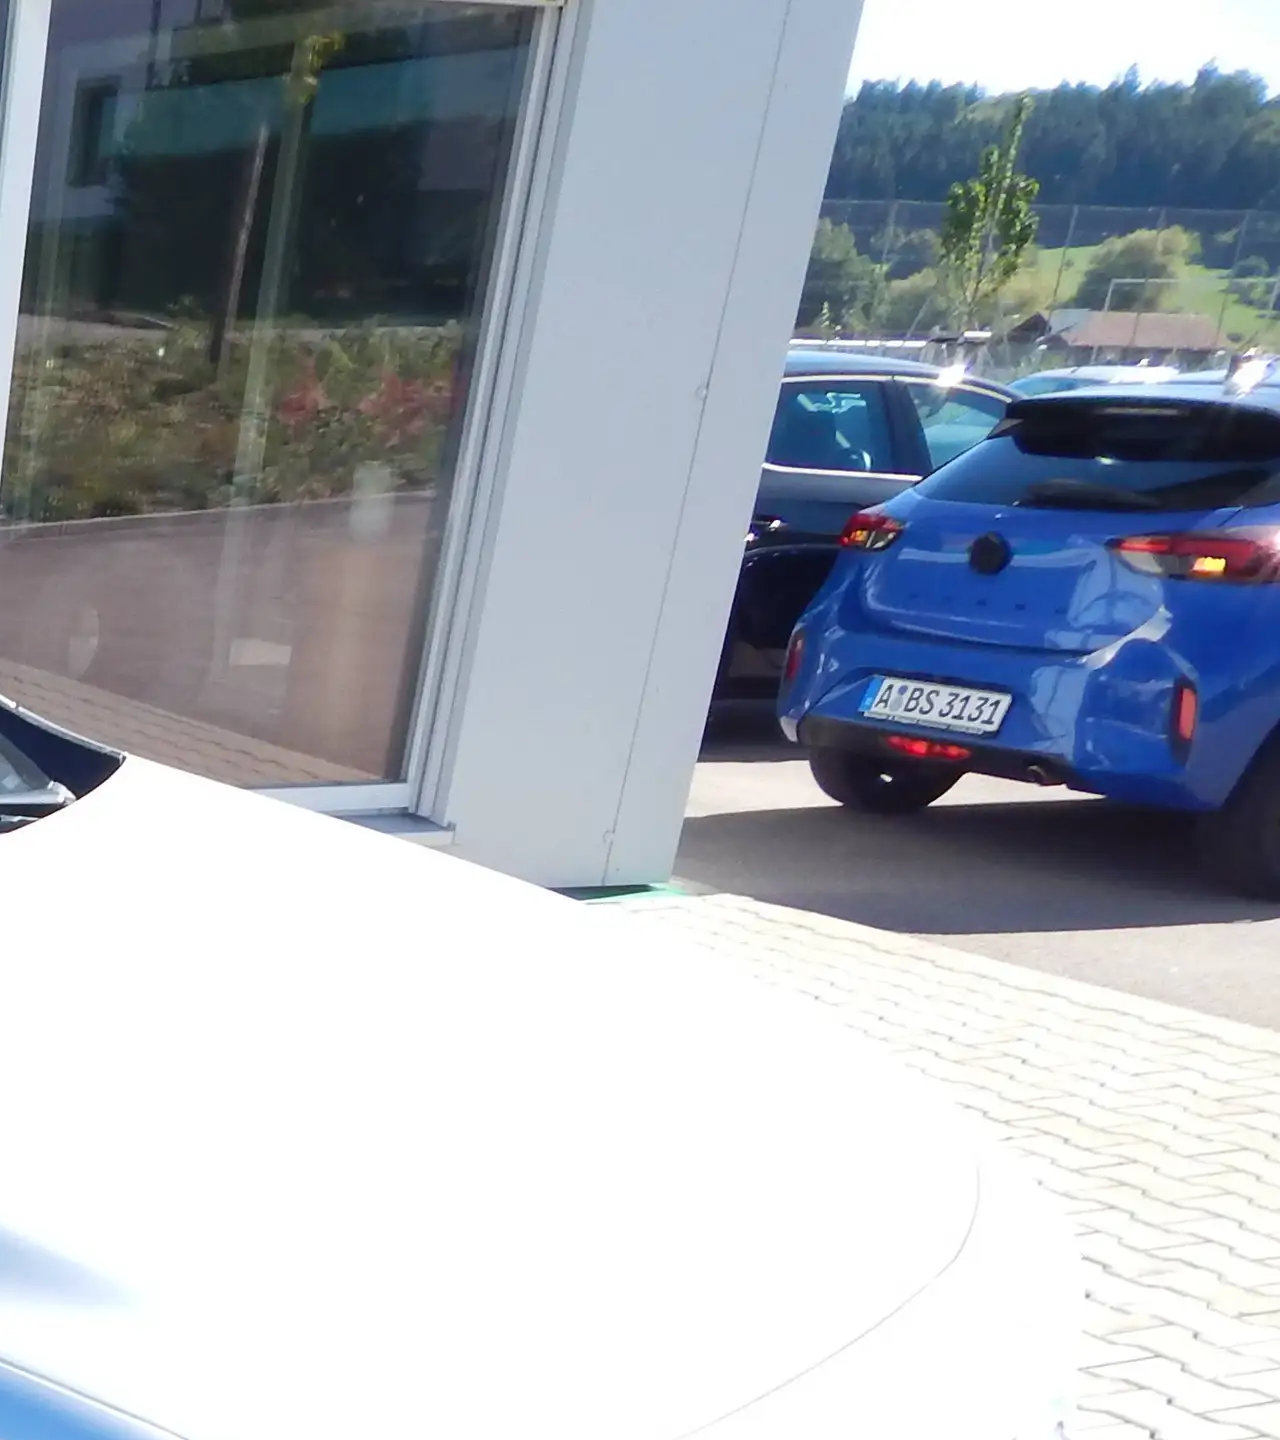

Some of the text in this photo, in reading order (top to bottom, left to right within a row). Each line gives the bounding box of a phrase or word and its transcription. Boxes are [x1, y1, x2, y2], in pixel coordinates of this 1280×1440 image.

[874, 684, 894, 708] A
[903, 687, 940, 715] BS
[938, 692, 1001, 725] 3131
